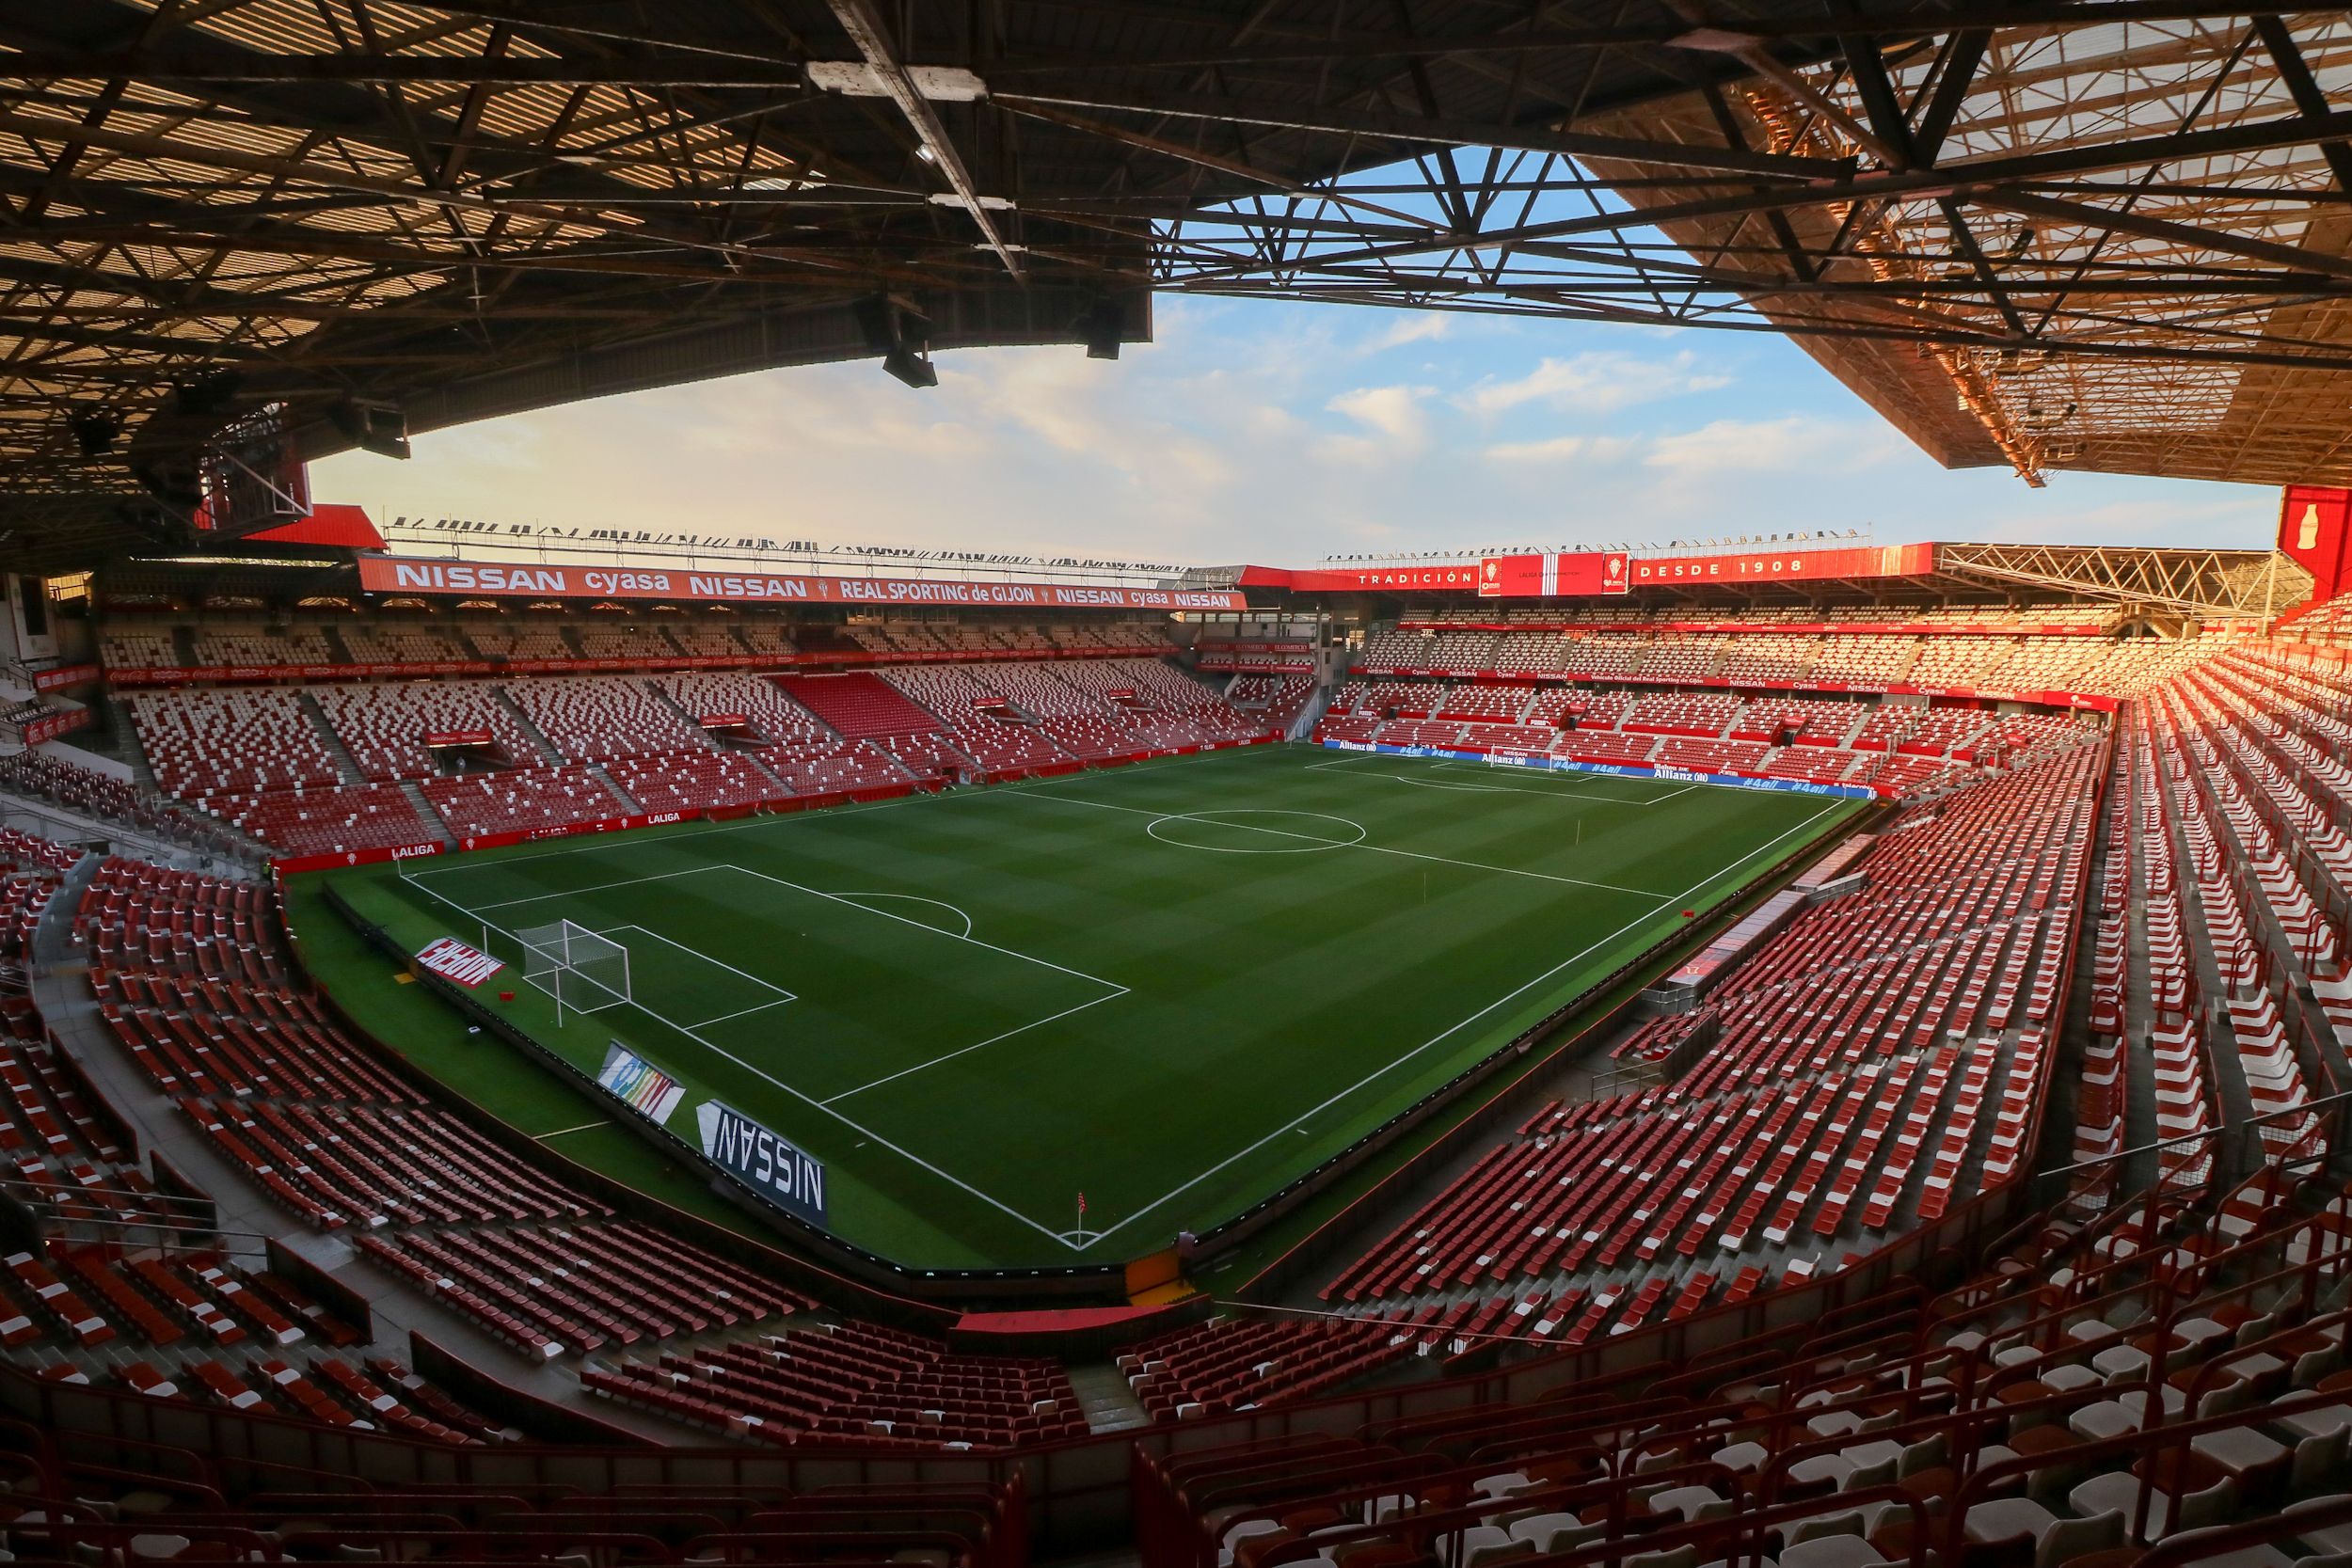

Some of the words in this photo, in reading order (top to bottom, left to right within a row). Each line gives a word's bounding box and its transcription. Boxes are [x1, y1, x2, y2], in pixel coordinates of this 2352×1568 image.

[1640, 563, 1719, 578] DESDE
[1740, 560, 1802, 574] 1908
[395, 564, 565, 591] NISSAN
[584, 569, 671, 594] cyasa
[1359, 570, 1471, 585] TRADICIÓN
[690, 576, 807, 598] NISSAN
[840, 580, 887, 600] REAL
[889, 581, 969, 603] SPORTING
[971, 584, 990, 602] de
[992, 585, 1036, 603] GIJON
[1056, 589, 1124, 605] NISSAN
[1130, 590, 1168, 607] cyasa
[1174, 594, 1232, 608] NISSAN
[1847, 685, 1888, 693] NISSAN
[1918, 687, 1946, 695] Cyasa
[1975, 690, 2015, 700] NISSAN
[1339, 741, 1365, 751] Allianz
[1399, 747, 1422, 755] #4all
[1431, 749, 1456, 758] #4all
[1482, 753, 1513, 764] Allianz
[1554, 760, 1581, 770] #4all
[1591, 764, 1621, 775] #4all
[1654, 769, 1692, 781] Allianz
[1743, 778, 1780, 789] #4all
[1791, 783, 1829, 794] #4all
[647, 813, 680, 824] LALIGA
[391, 844, 436, 860] LALIGA
[717, 1113, 823, 1212] NISSAN
